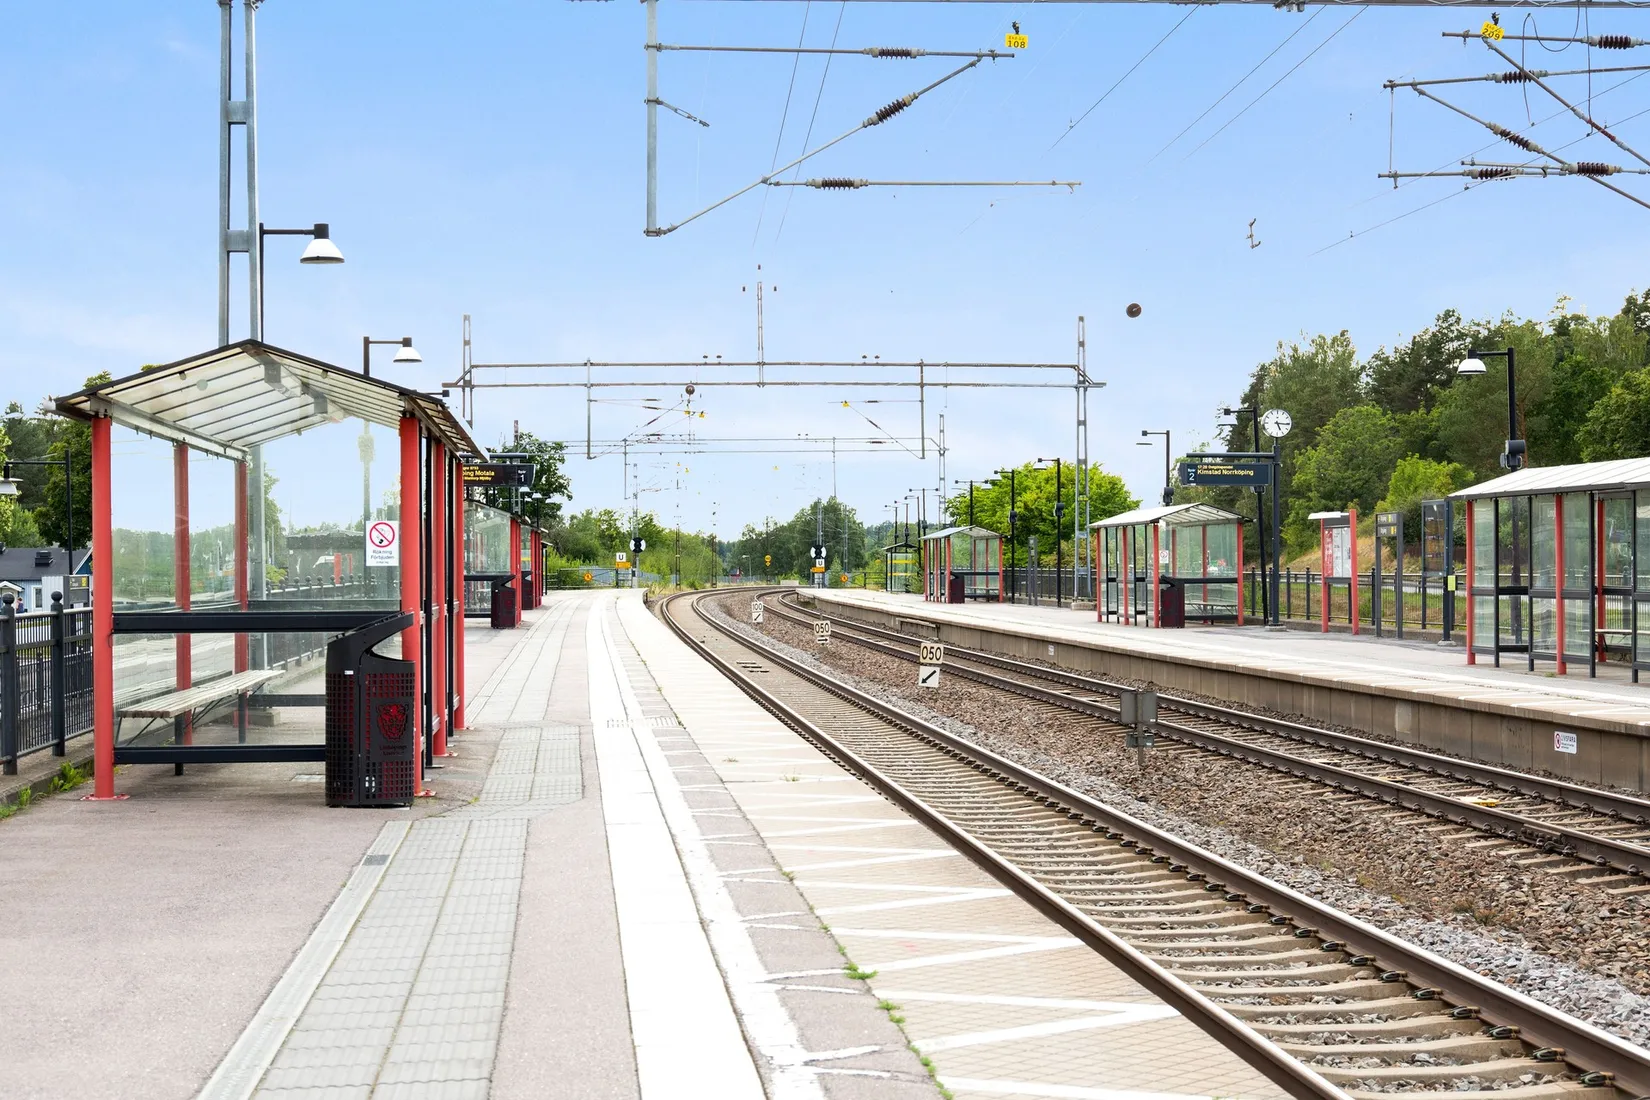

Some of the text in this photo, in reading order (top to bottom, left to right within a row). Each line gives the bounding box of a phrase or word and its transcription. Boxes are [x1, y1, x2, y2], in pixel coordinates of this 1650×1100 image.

[1482, 28, 1500, 41] 209
[1007, 40, 1026, 48] 108
[815, 622, 829, 633] 050
[922, 646, 941, 661] 050
